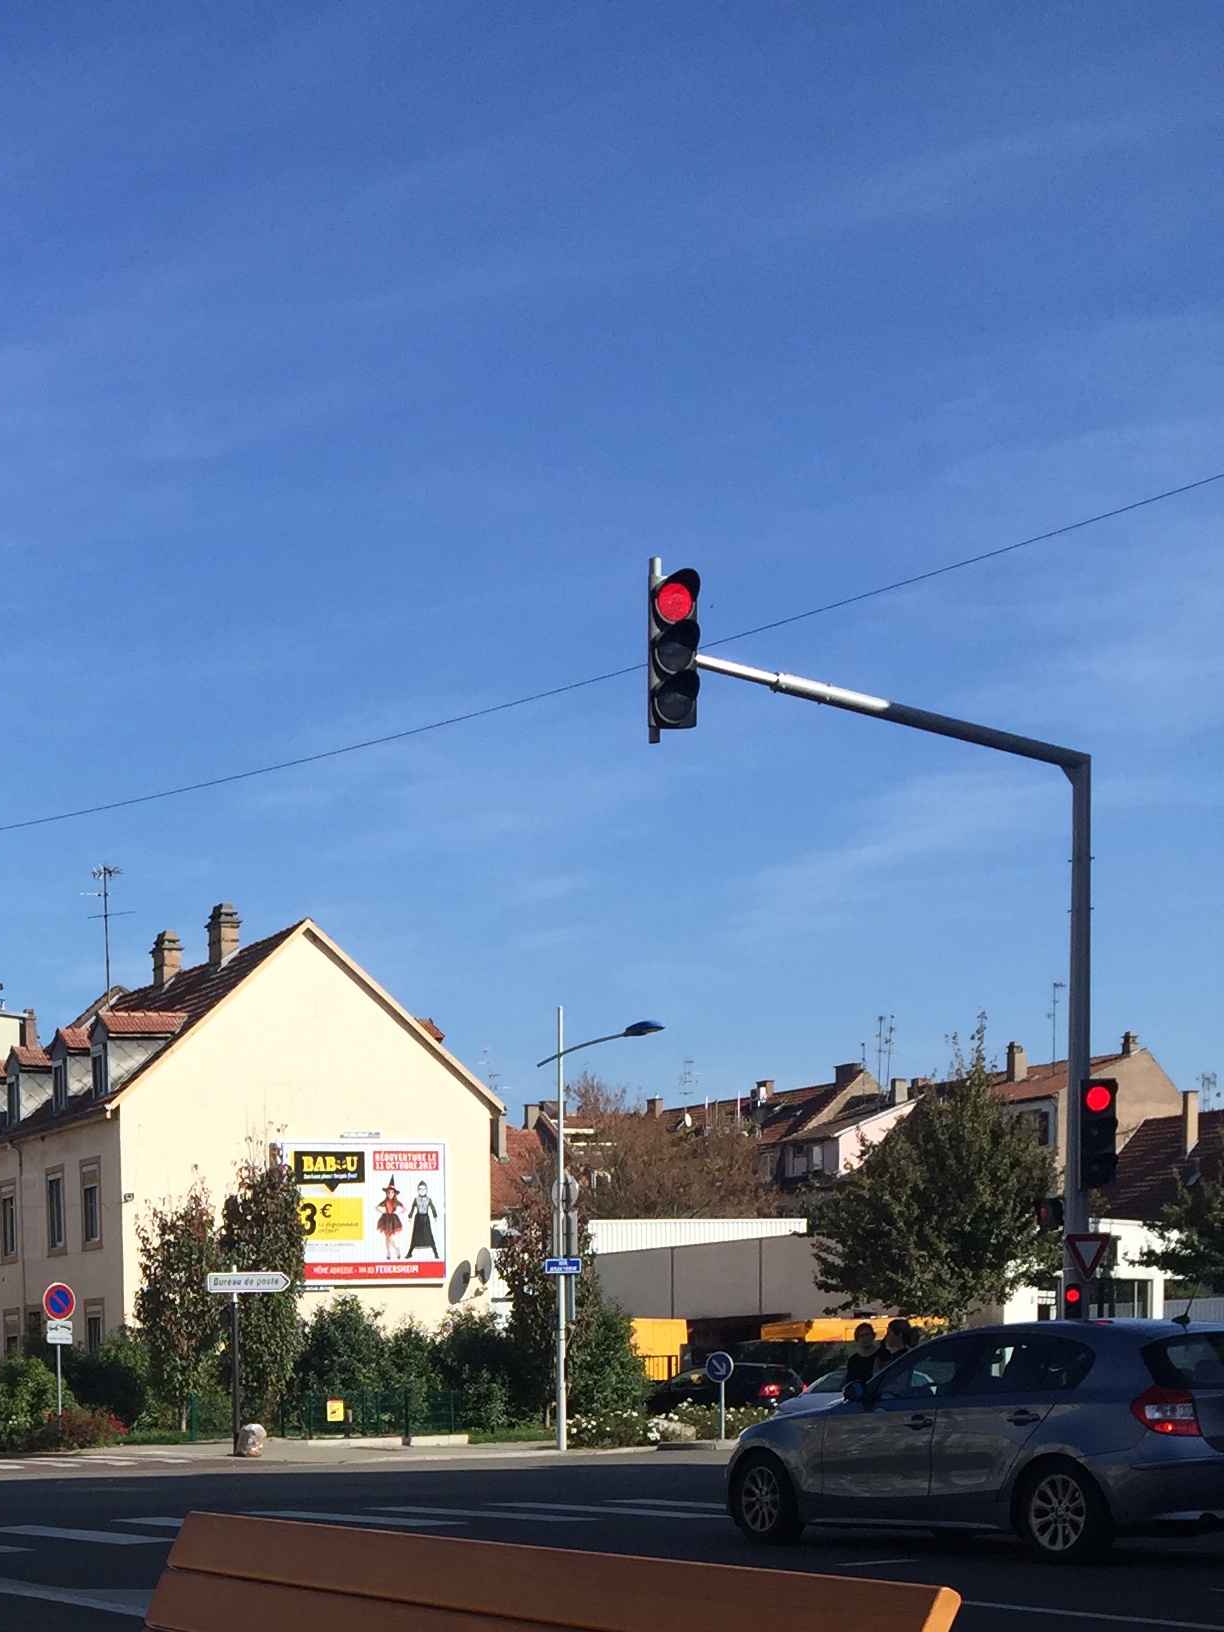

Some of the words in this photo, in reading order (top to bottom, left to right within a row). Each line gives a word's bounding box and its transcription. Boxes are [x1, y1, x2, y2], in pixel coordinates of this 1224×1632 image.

[320, 1203, 332, 1218] €
[213, 1278, 241, 1286] Bureau
[244, 1277, 253, 1285] de
[256, 1277, 279, 1287] poste
